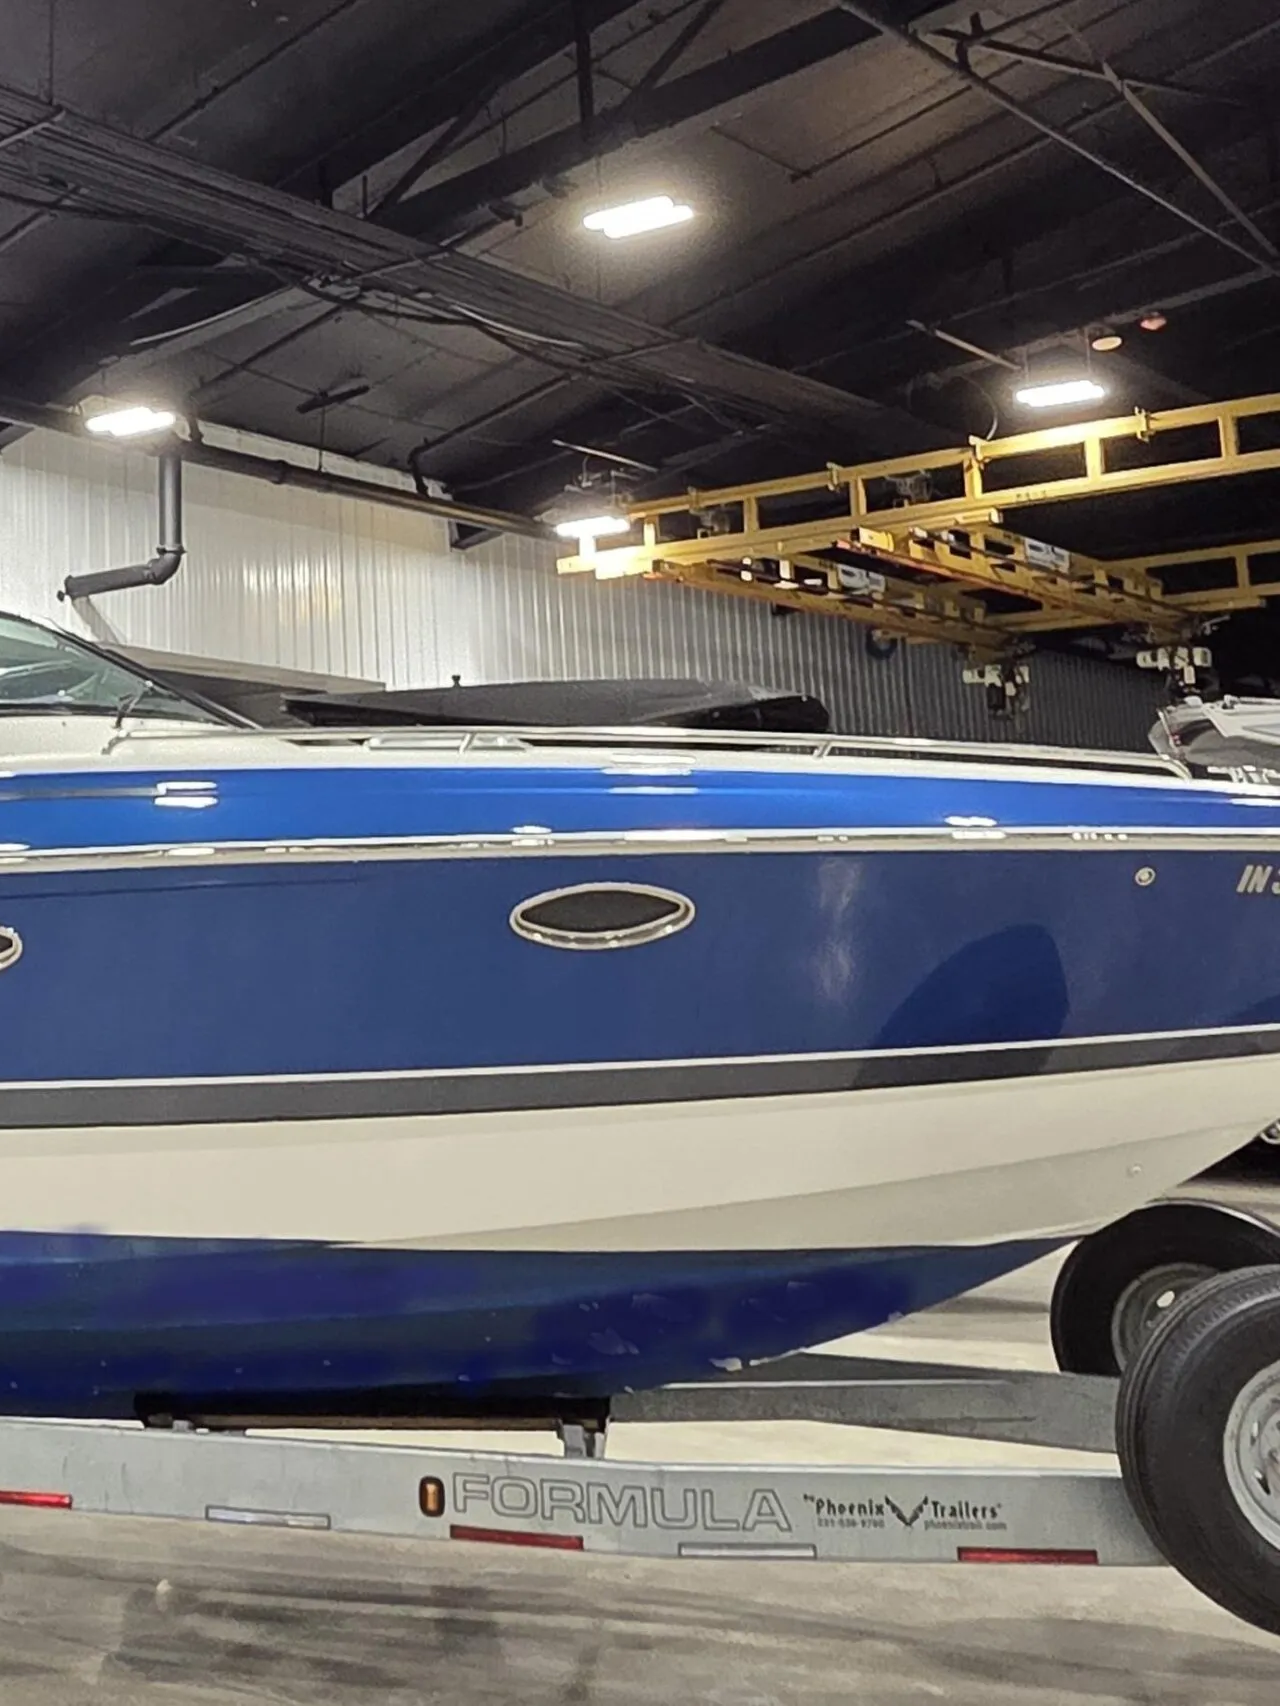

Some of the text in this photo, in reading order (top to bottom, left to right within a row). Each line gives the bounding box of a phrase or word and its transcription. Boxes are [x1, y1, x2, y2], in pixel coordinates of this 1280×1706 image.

[1236, 864, 1273, 893] IN
[452, 1471, 793, 1533] FORMULA
[815, 1497, 885, 1516] Phoenix
[931, 1499, 998, 1519] Trailers
